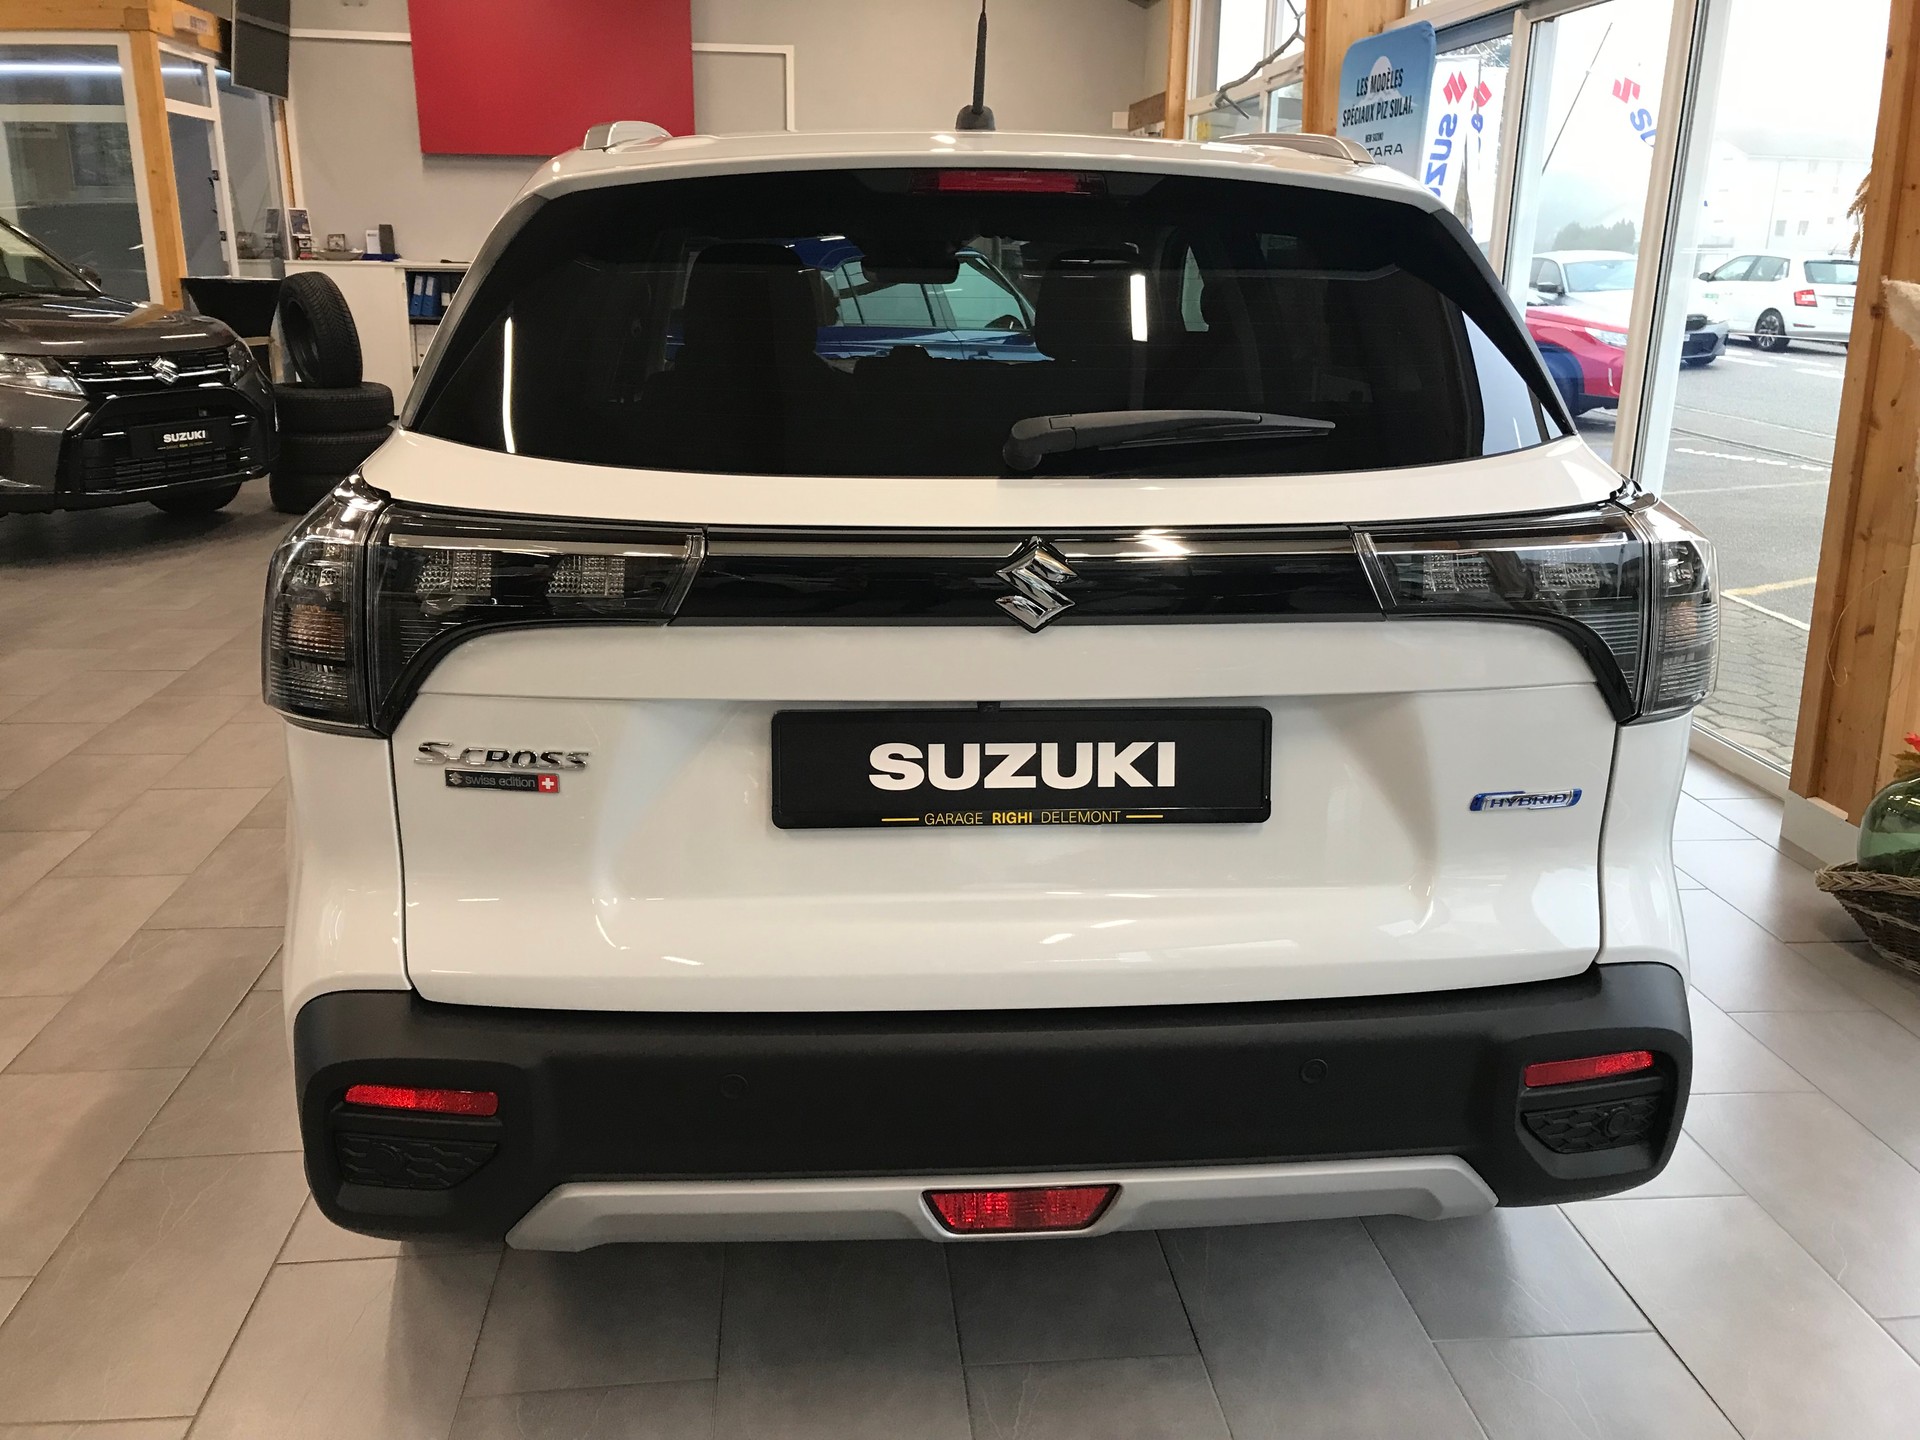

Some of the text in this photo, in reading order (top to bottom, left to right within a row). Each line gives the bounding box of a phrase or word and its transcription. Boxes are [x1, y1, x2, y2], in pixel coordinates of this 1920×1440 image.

[1356, 67, 1404, 97] LES MODÈLES
[1342, 95, 1413, 128] SPÉCIAUX PIZ SULAI.
[163, 430, 206, 443] SUZUKI
[868, 741, 1176, 791] SUZUKI
[465, 774, 536, 788] swiss edition
[1489, 793, 1568, 809] HYBRID
[924, 810, 1122, 825] GARAGE RIGHI DELEMONT
